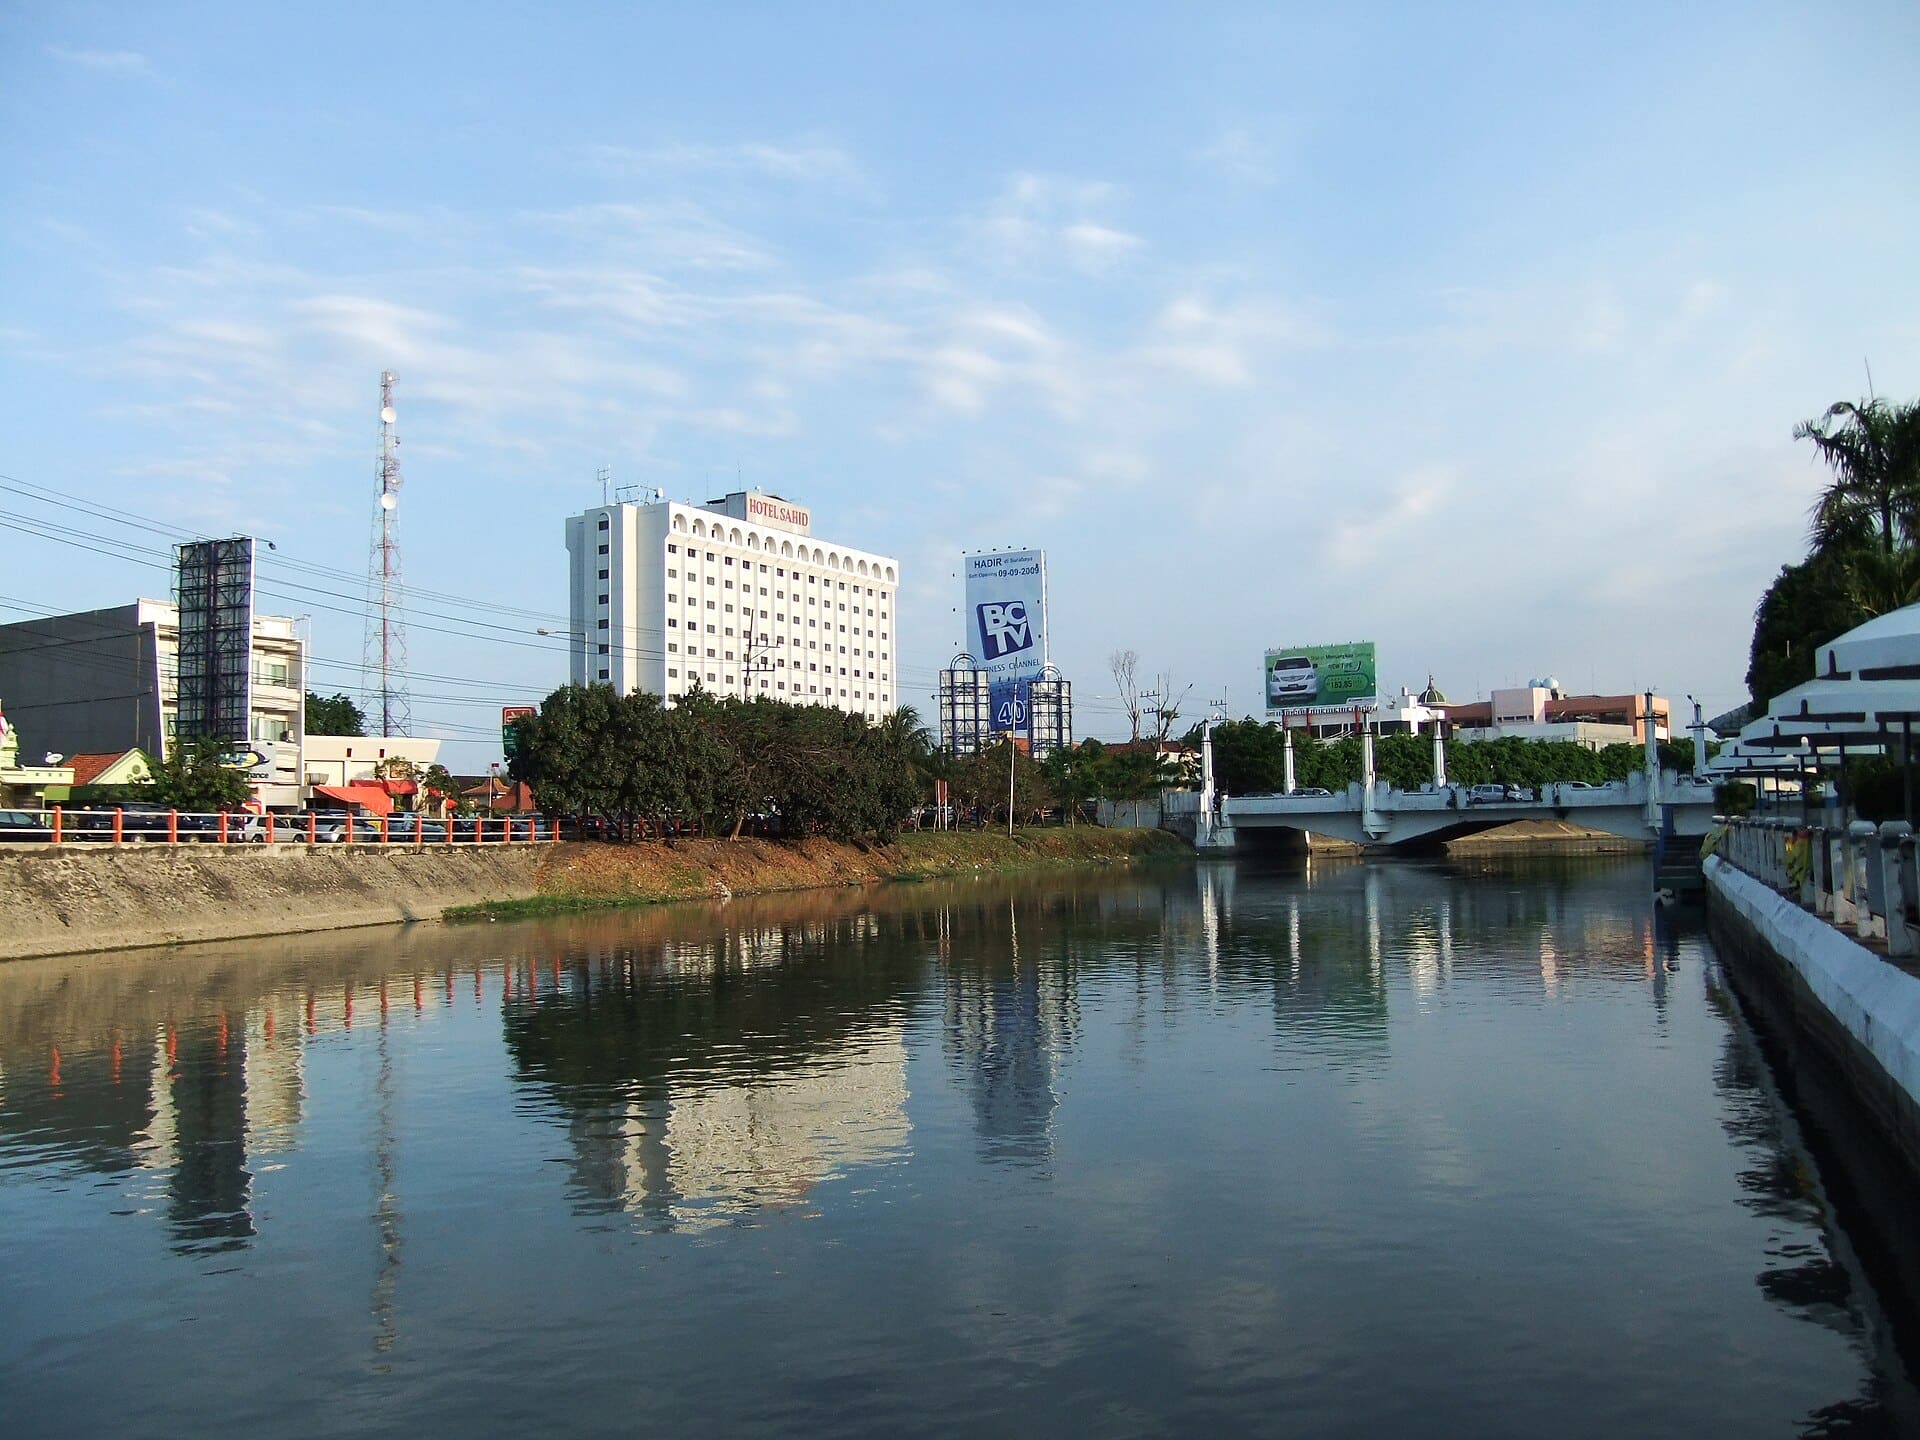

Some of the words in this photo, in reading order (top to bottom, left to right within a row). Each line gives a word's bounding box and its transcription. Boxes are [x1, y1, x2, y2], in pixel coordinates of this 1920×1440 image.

[749, 498, 778, 520] HOTEL
[779, 507, 808, 527] SAHID
[974, 557, 1002, 569] HADIR
[998, 566, 1040, 578] 09-09-2009
[998, 700, 1026, 725] 40
[247, 771, 269, 779] nance
